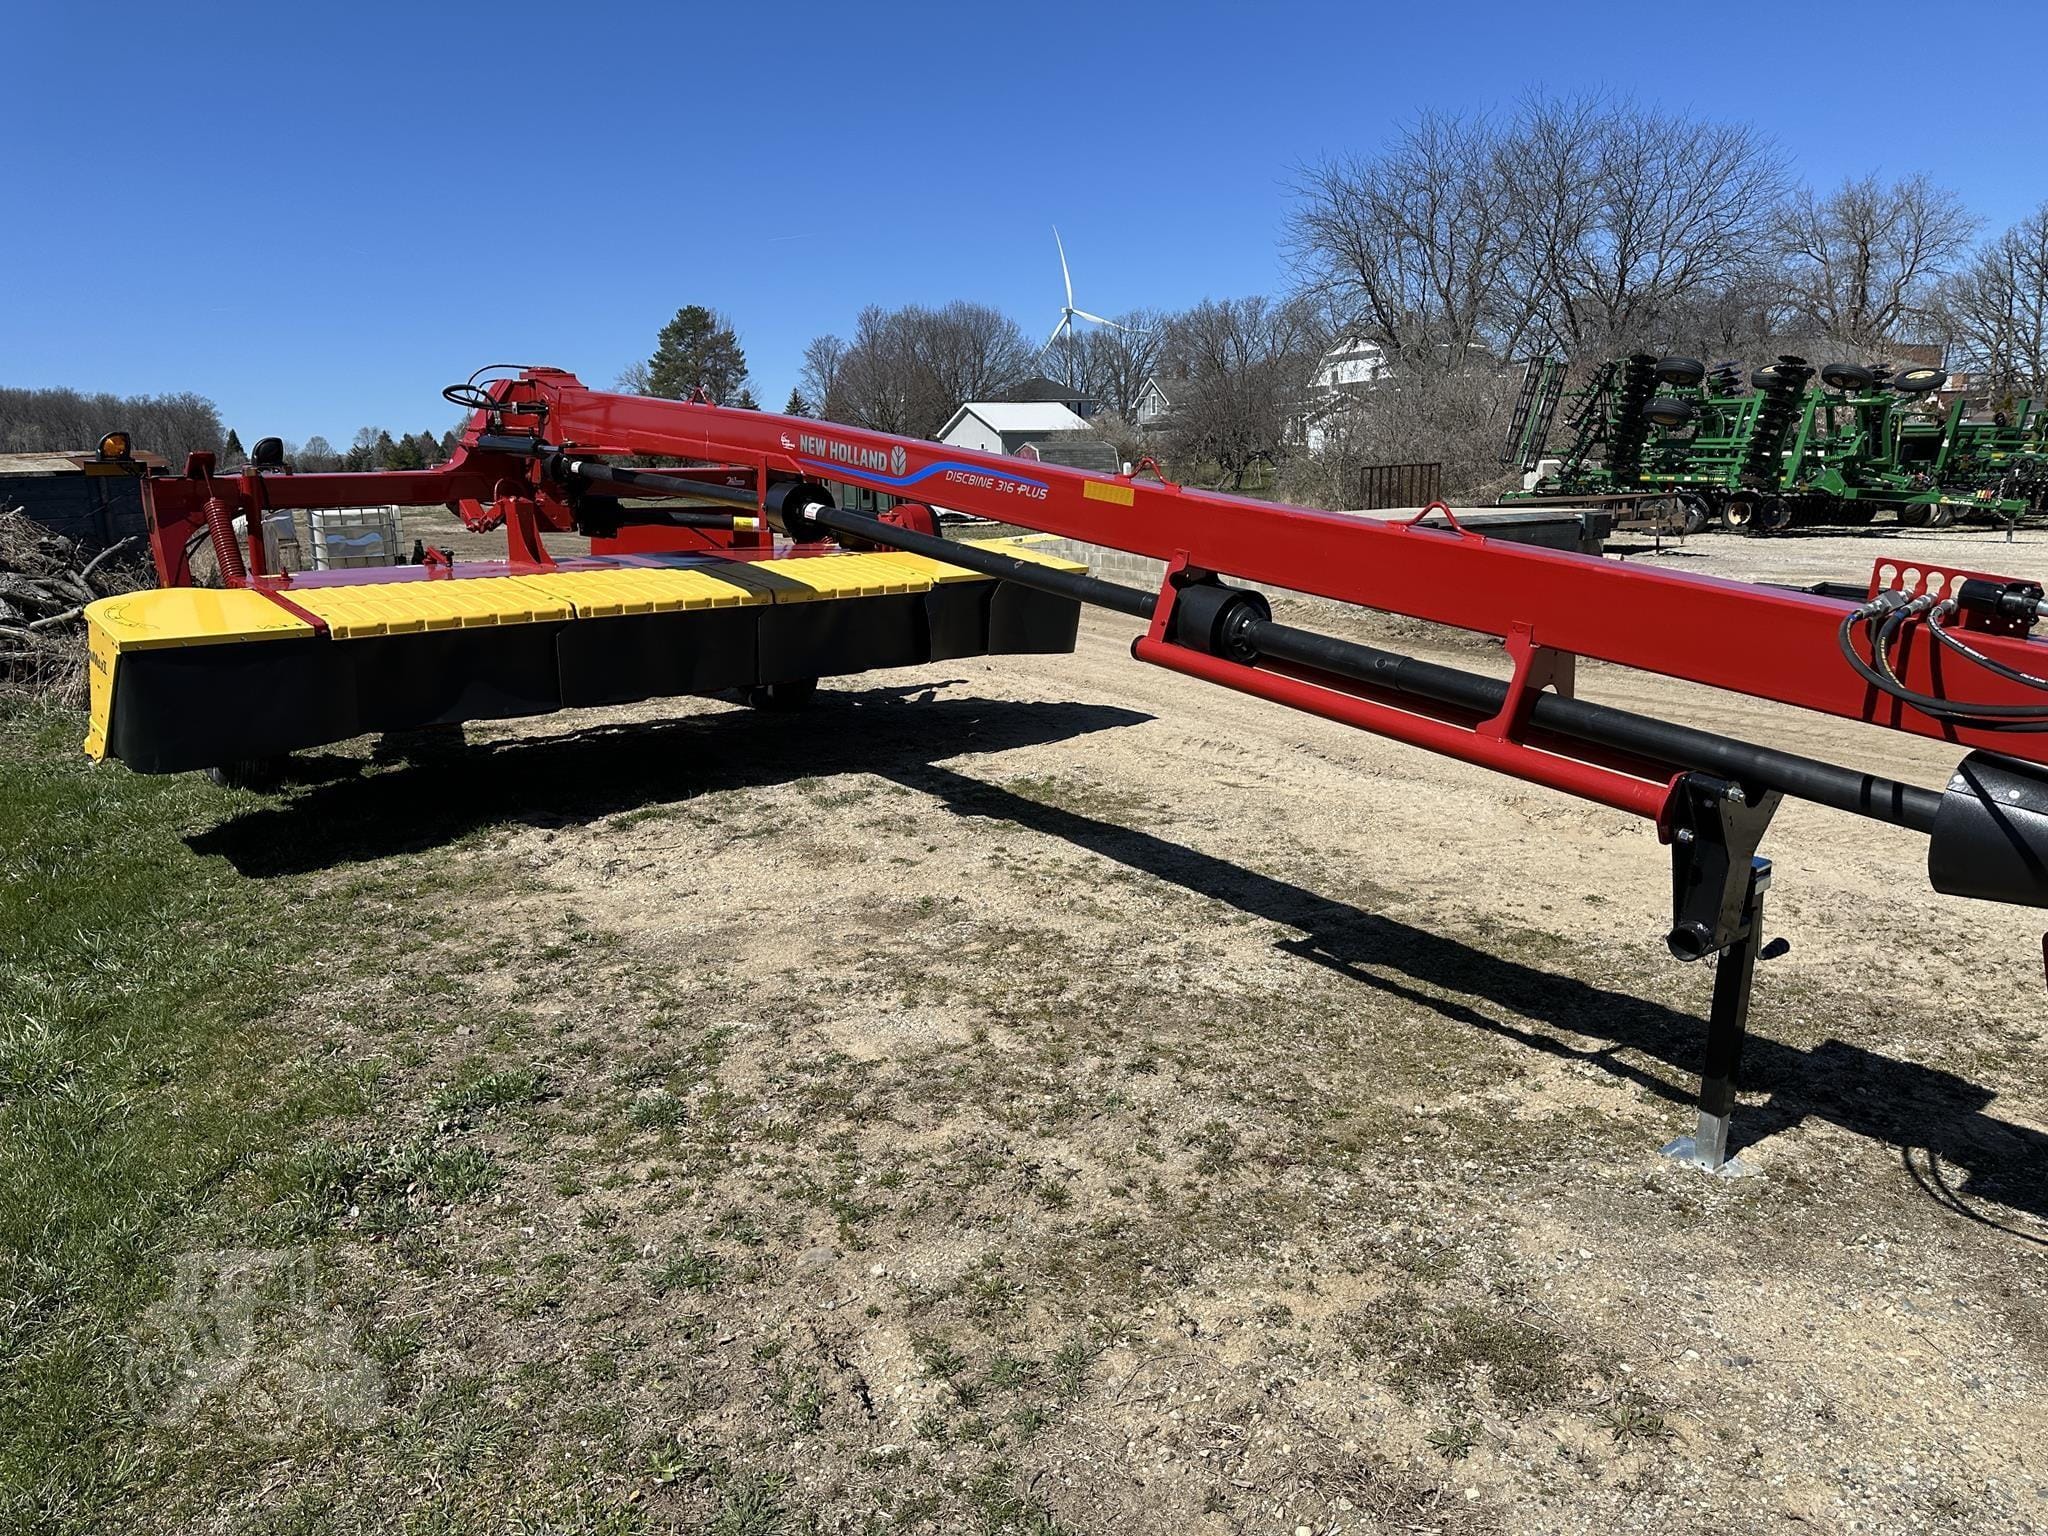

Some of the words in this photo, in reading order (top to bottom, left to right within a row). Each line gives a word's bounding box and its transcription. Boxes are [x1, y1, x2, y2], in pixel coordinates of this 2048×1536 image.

[799, 434, 827, 457] NEW
[829, 440, 887, 472] HOLLAND
[945, 470, 994, 489] DISCBINE
[995, 480, 1015, 493] 316
[1017, 484, 1048, 500] PLUS
